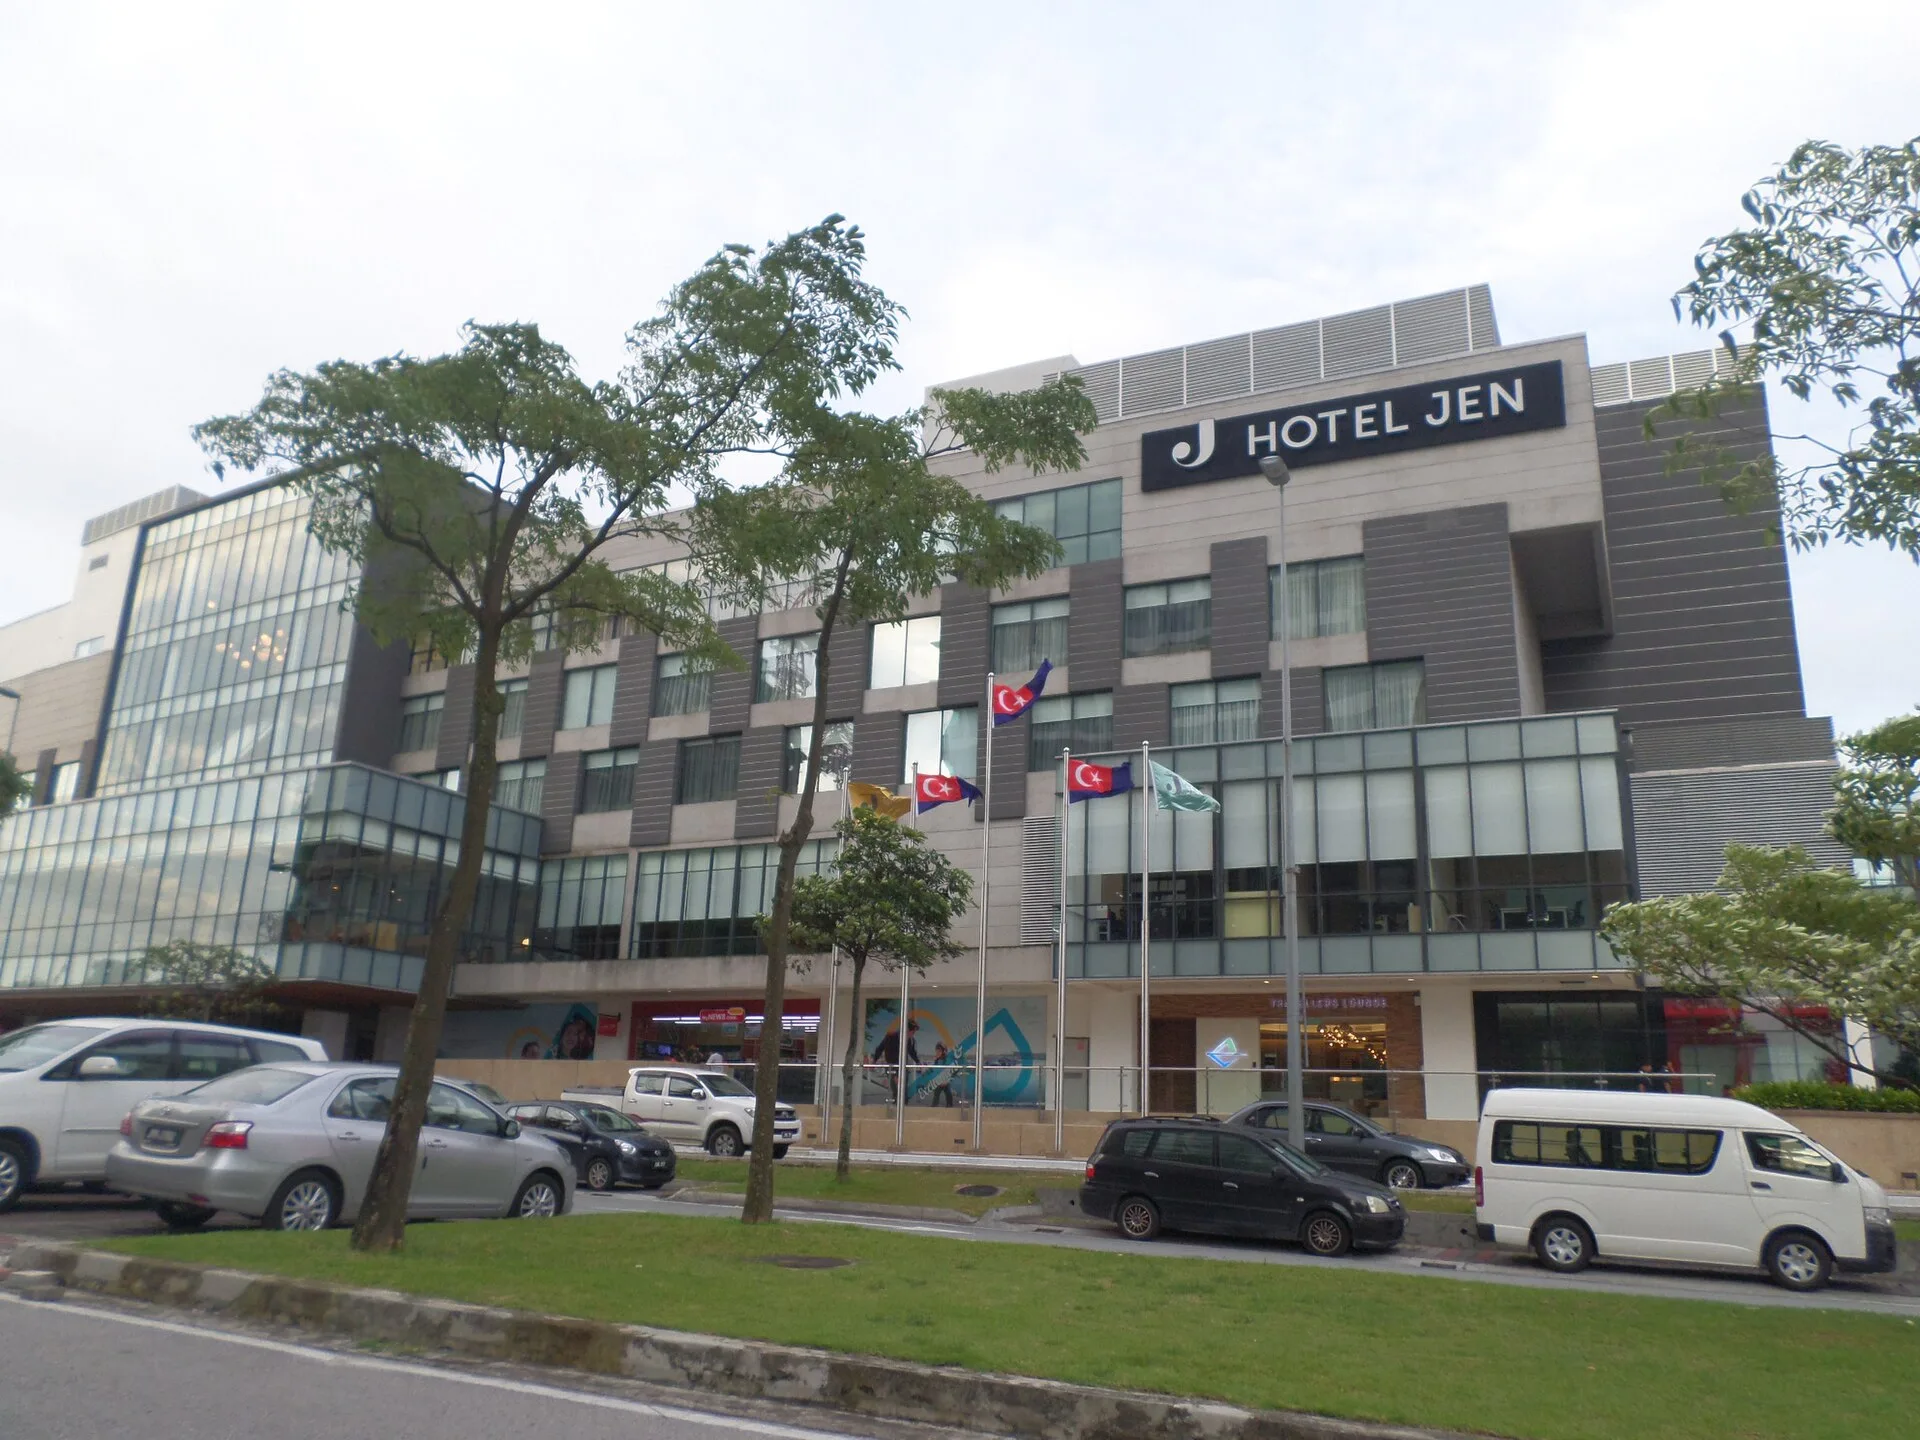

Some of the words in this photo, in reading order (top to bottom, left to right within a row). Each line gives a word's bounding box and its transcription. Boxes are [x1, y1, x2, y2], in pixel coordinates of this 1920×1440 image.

[1171, 418, 1215, 467] J
[1247, 401, 1409, 456] HOTEL
[1425, 378, 1525, 426] JEN
